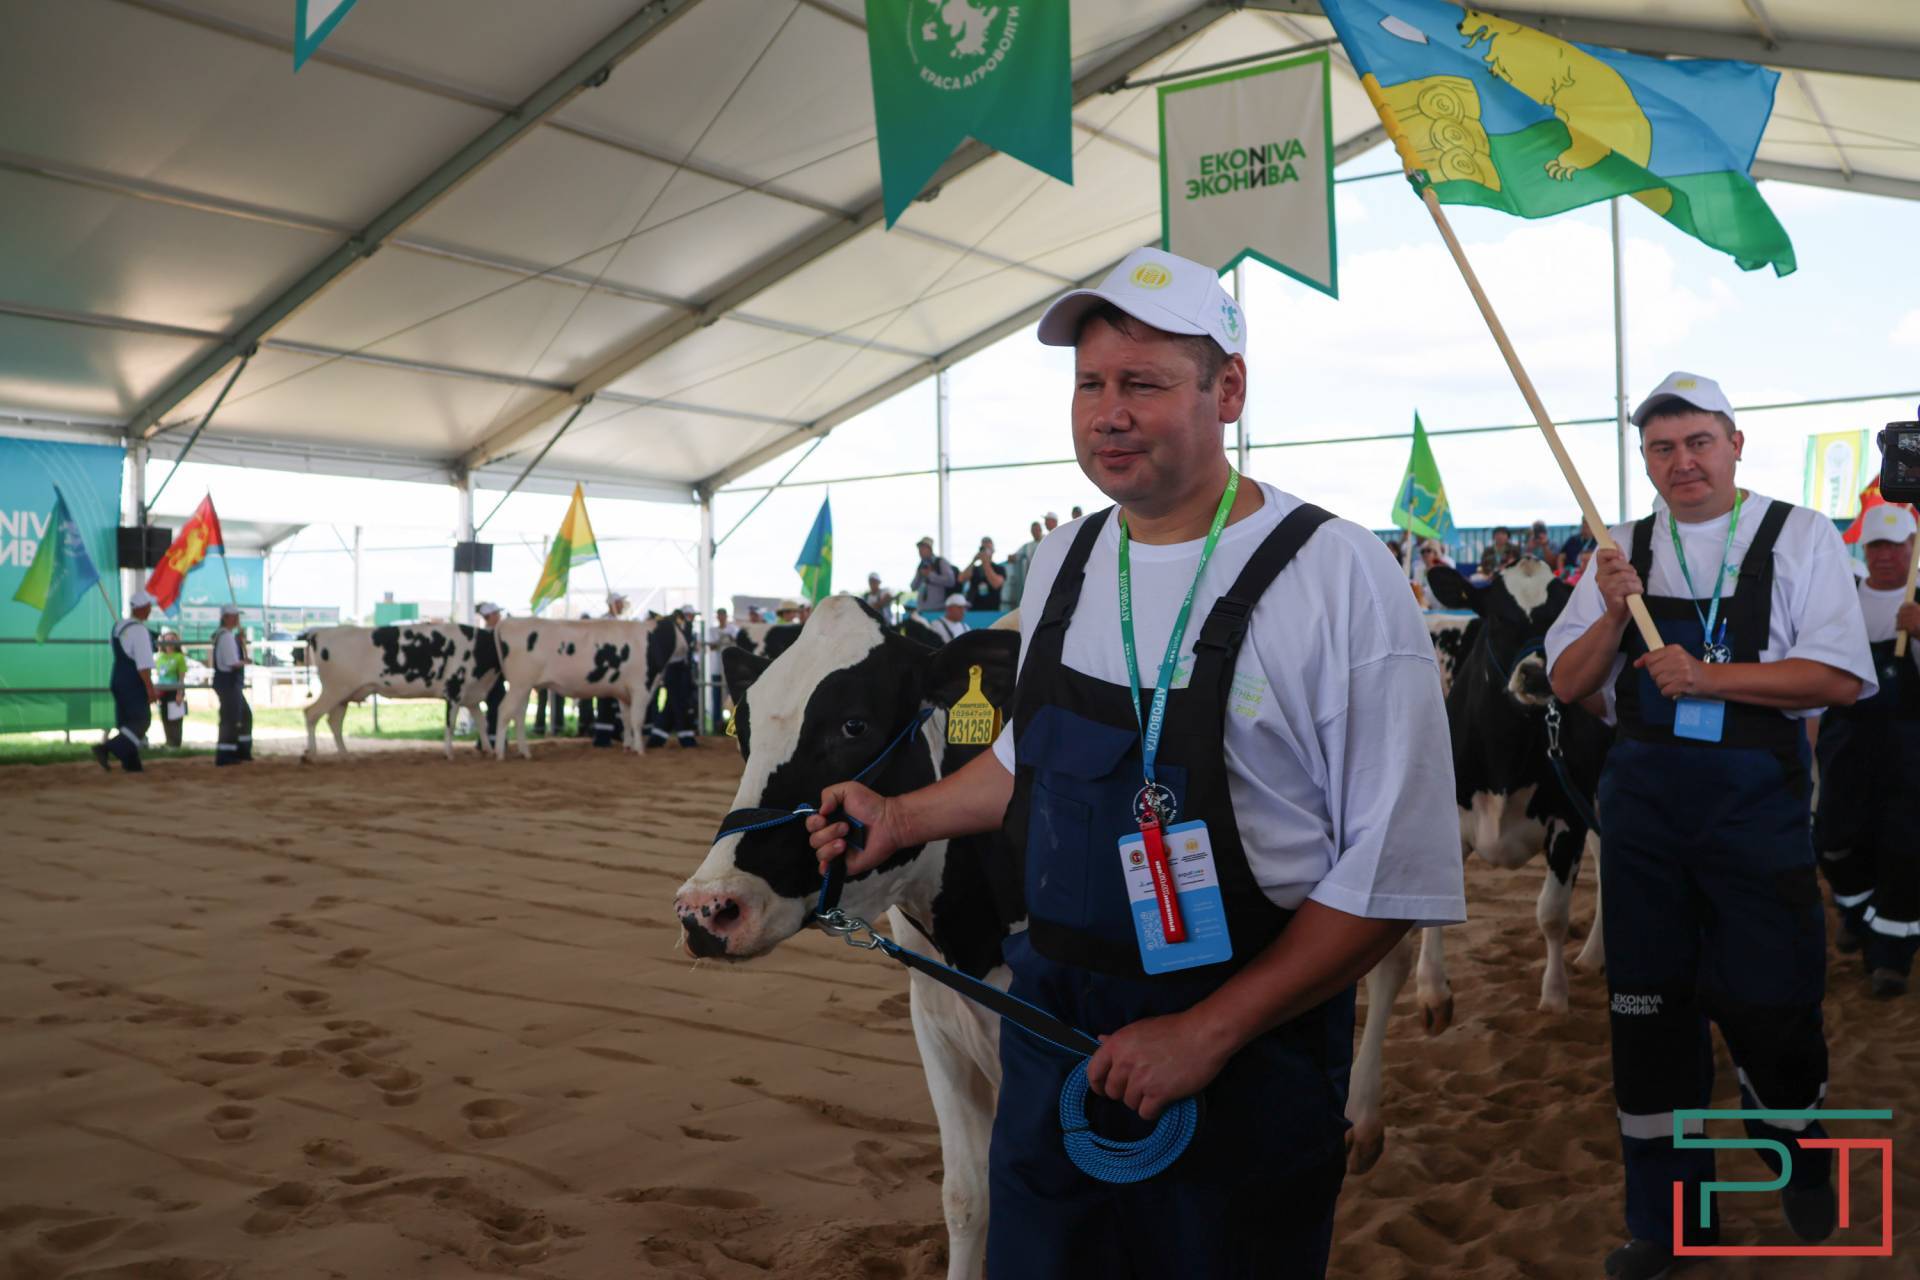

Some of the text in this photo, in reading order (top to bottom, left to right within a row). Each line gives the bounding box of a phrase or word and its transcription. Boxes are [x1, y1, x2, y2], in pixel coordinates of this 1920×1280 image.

[920, 5, 1020, 90] КРАСА АГРОВОЛГИ
[1200, 138, 1306, 175] EKONIVA
[1185, 162, 1299, 200] ЭКОНИВА
[0, 511, 52, 539] NIV
[0, 540, 38, 567] ИВ
[1119, 569, 1131, 621] АГРОВОЛГА
[949, 719, 991, 742] 231258
[1146, 687, 1166, 752] АГРОВОЛГА
[1614, 993, 1663, 1004] EKONIVA
